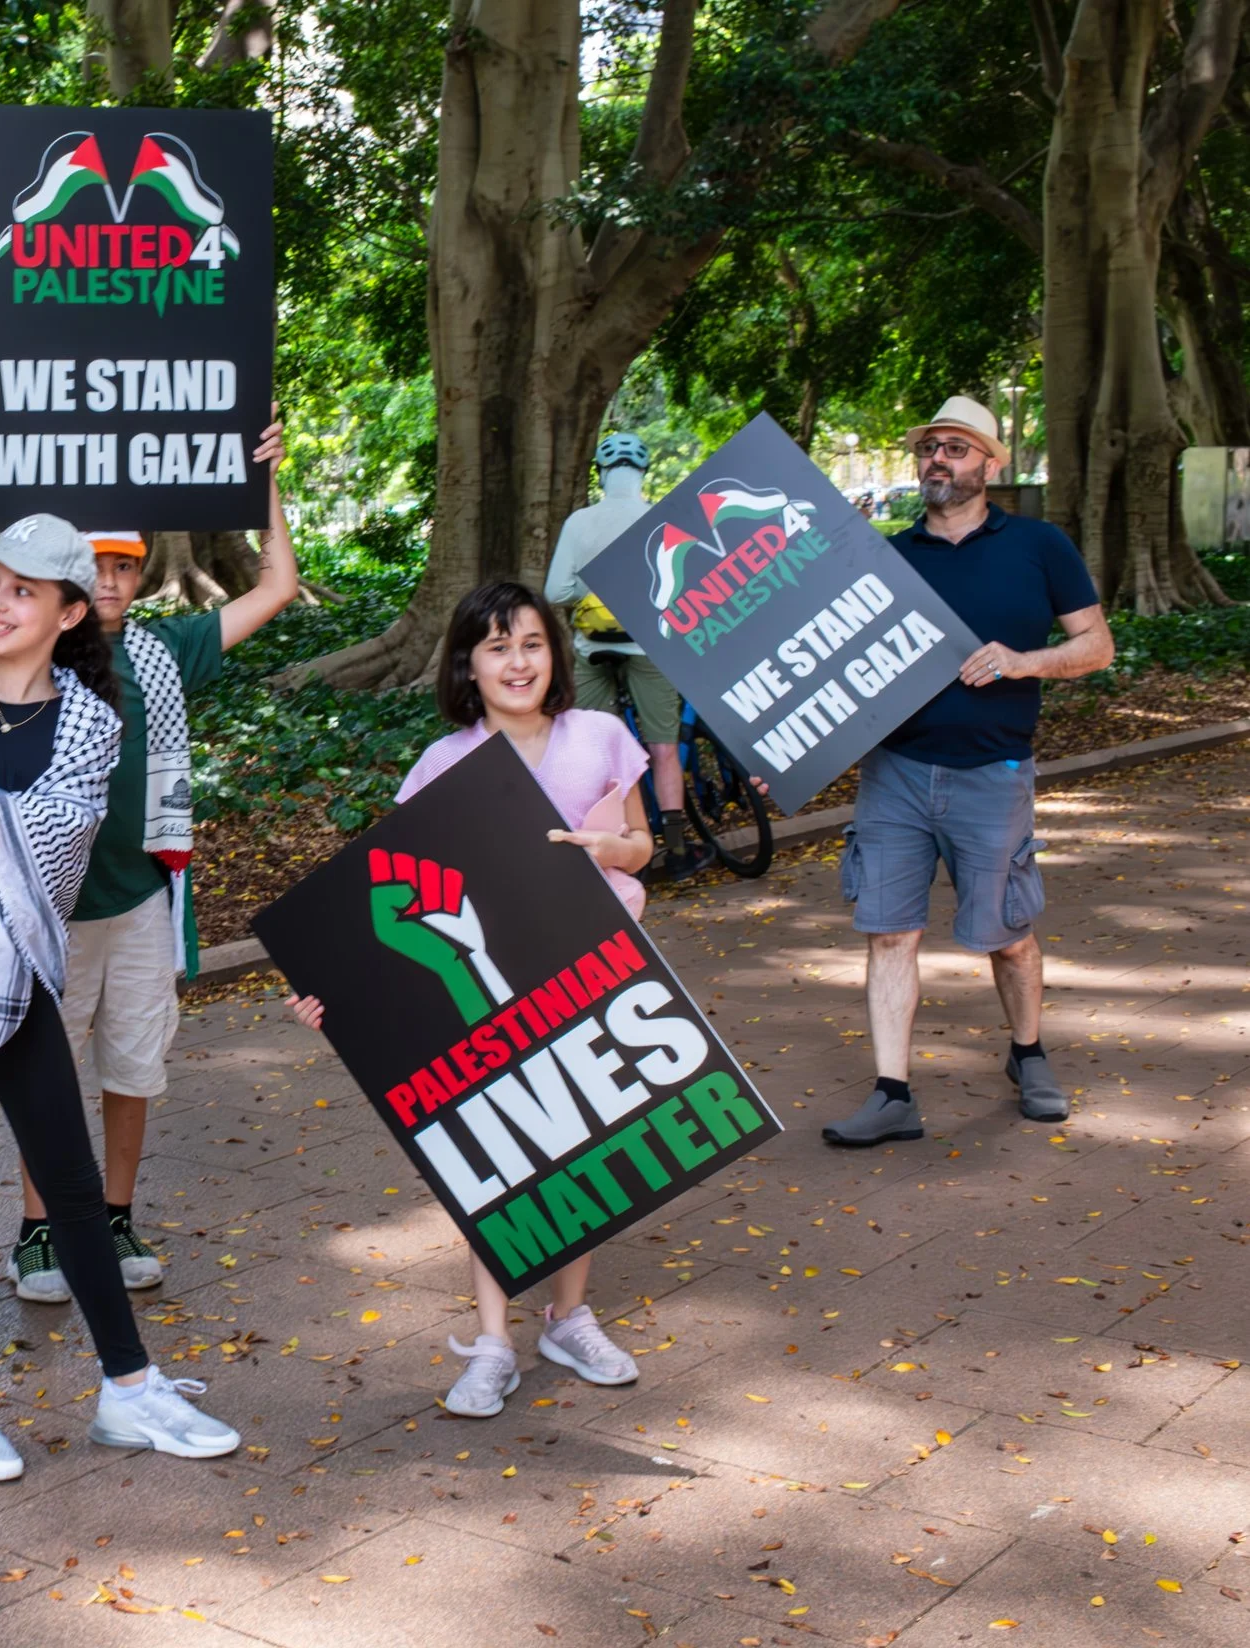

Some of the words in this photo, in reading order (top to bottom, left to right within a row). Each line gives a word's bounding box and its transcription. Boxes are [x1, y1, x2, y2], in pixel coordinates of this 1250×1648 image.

[13, 264, 225, 318] PALESTINE
[0, 359, 77, 412] WE
[85, 358, 237, 412] STAND
[128, 433, 247, 485] GAZA
[684, 526, 832, 657] PALESTINE
[720, 658, 793, 724] WE
[776, 572, 896, 678] STAND
[751, 678, 860, 775] WITH
[842, 609, 946, 700] GAZA
[384, 929, 648, 1128] PALESTINIAN
[413, 980, 710, 1217] LIVES
[475, 1070, 765, 1280] MATTER
